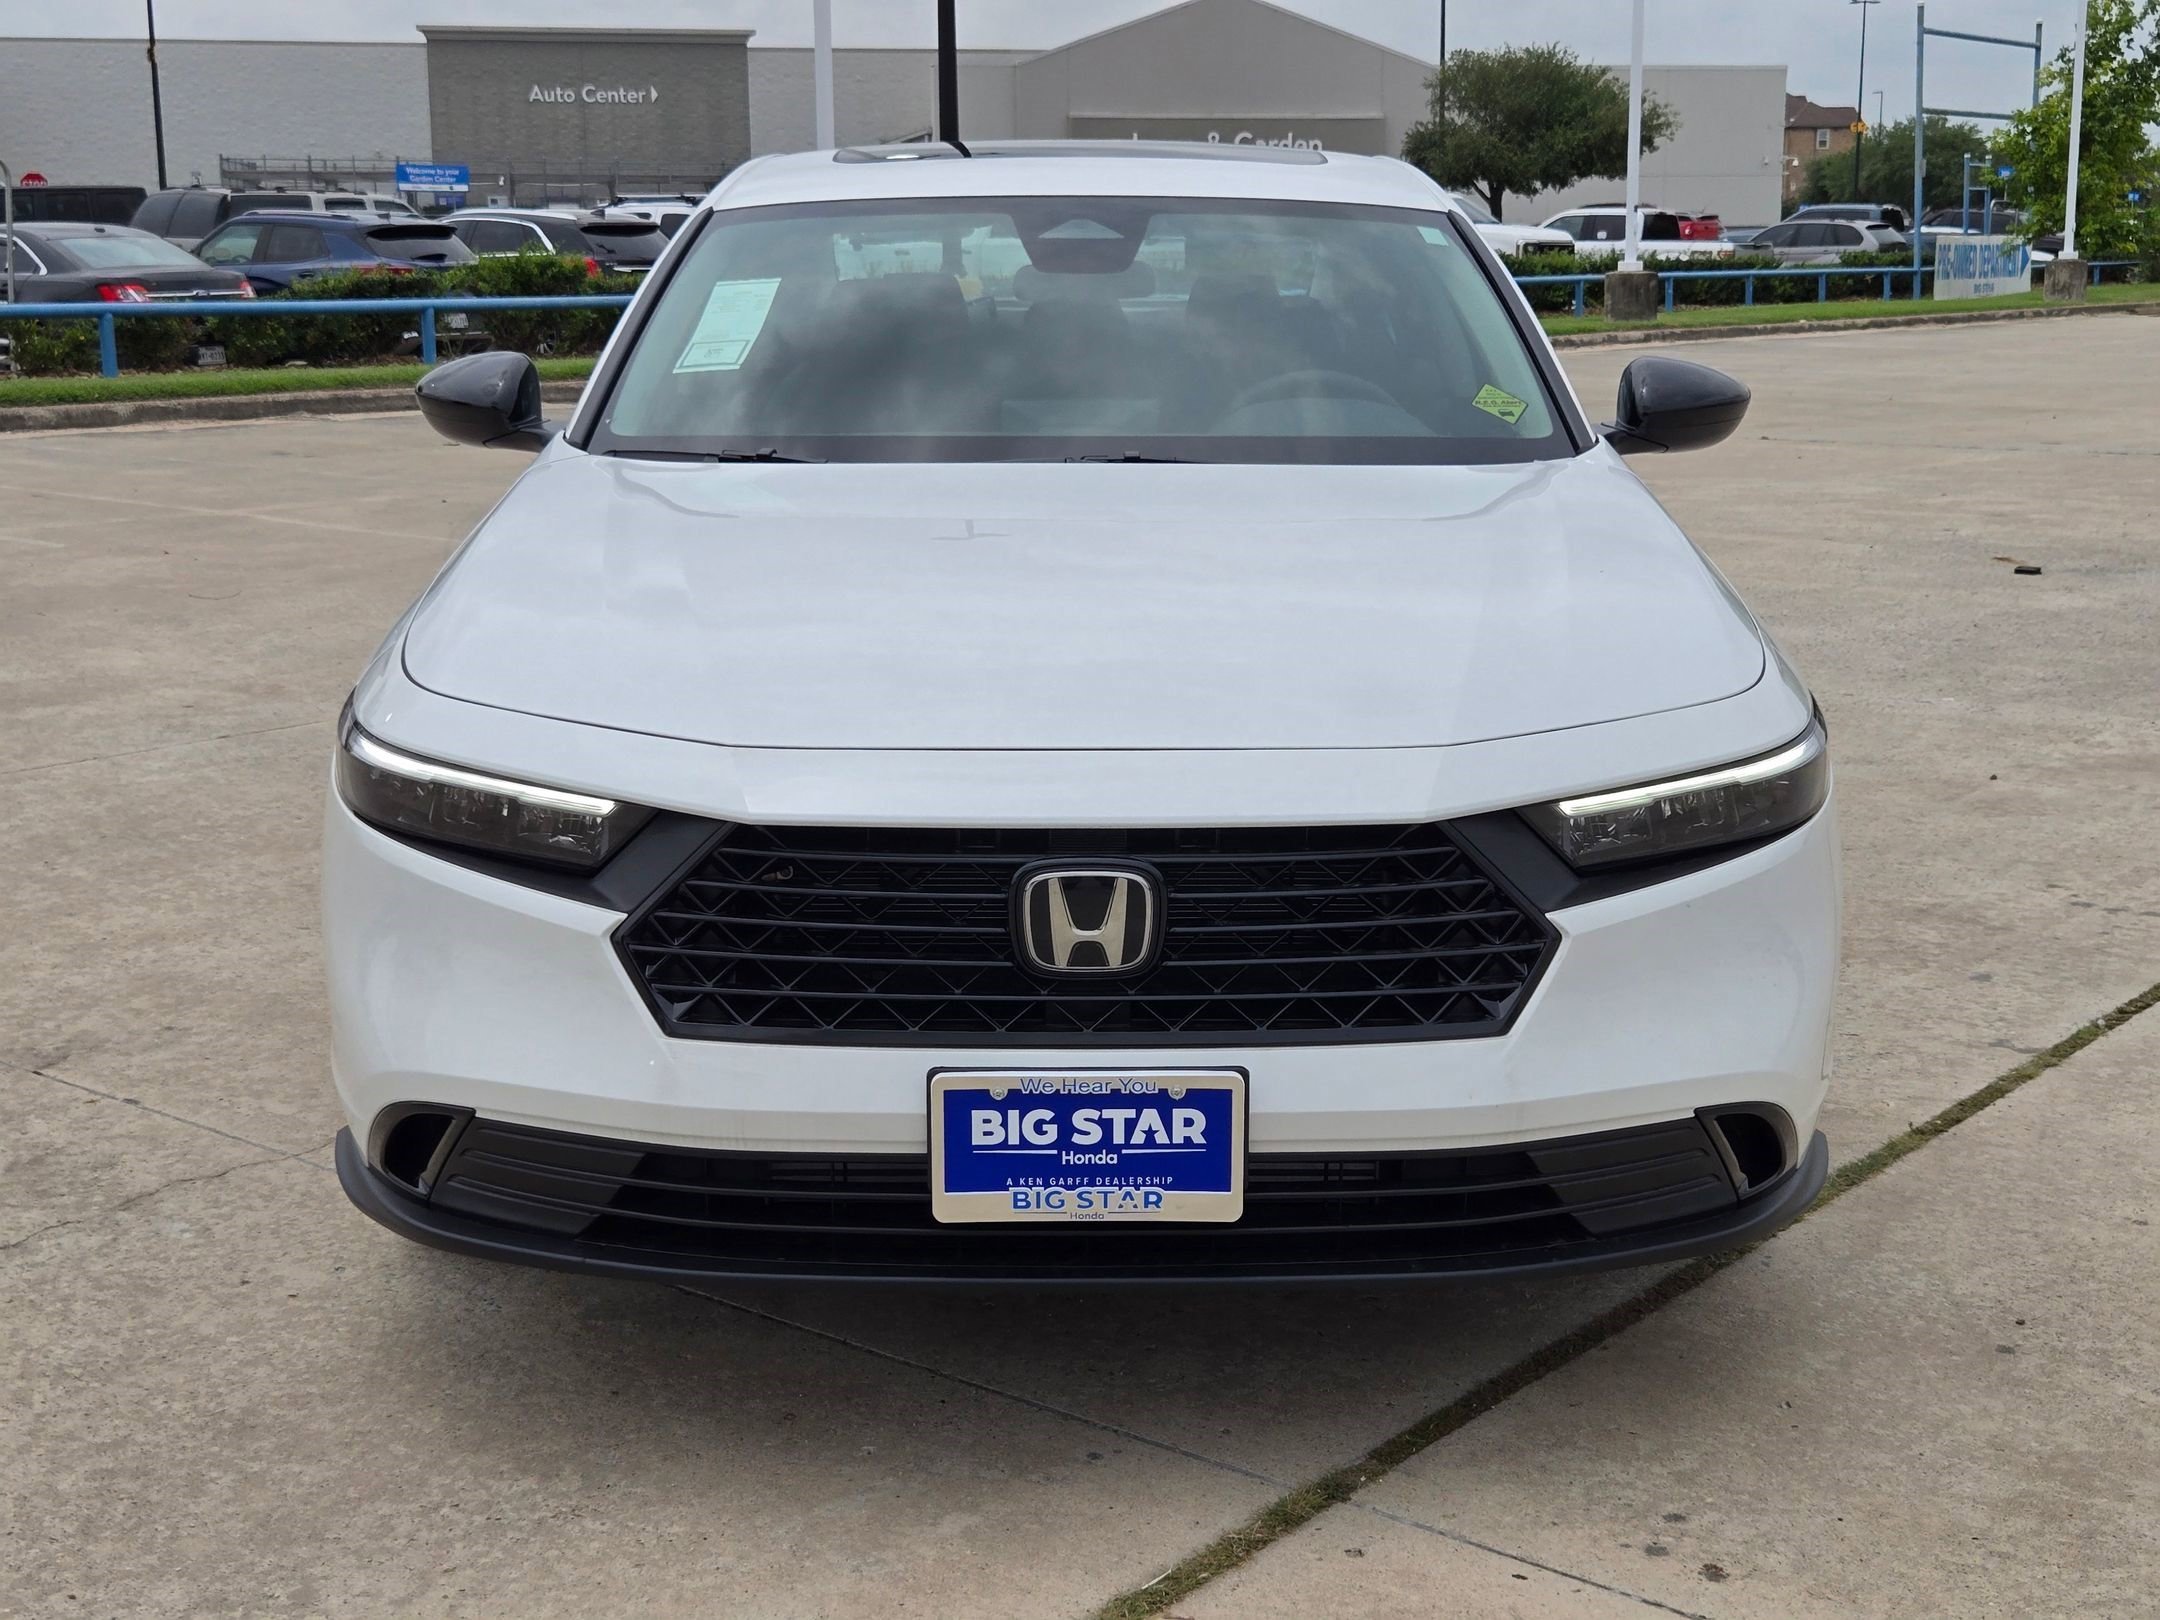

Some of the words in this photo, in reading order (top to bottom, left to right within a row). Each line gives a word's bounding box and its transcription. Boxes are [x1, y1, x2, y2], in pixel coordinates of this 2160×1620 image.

[529, 84, 575, 103] Auto
[582, 84, 646, 103] Center
[1020, 1077, 1054, 1094] We
[1062, 1077, 1112, 1094] Hear
[1119, 1077, 1157, 1094] You
[971, 1108, 1058, 1146] BIG
[1071, 1108, 1207, 1145] STAR
[1061, 1149, 1118, 1165] Honda
[1006, 1178, 1013, 1186] A
[1019, 1177, 1043, 1186] KEN
[1049, 1177, 1089, 1186] GARFF
[1096, 1176, 1173, 1186] DEALERSHIP
[1012, 1190, 1066, 1209] BIG
[1076, 1190, 1163, 1209] STAR
[1070, 1212, 1105, 1220] Honda
